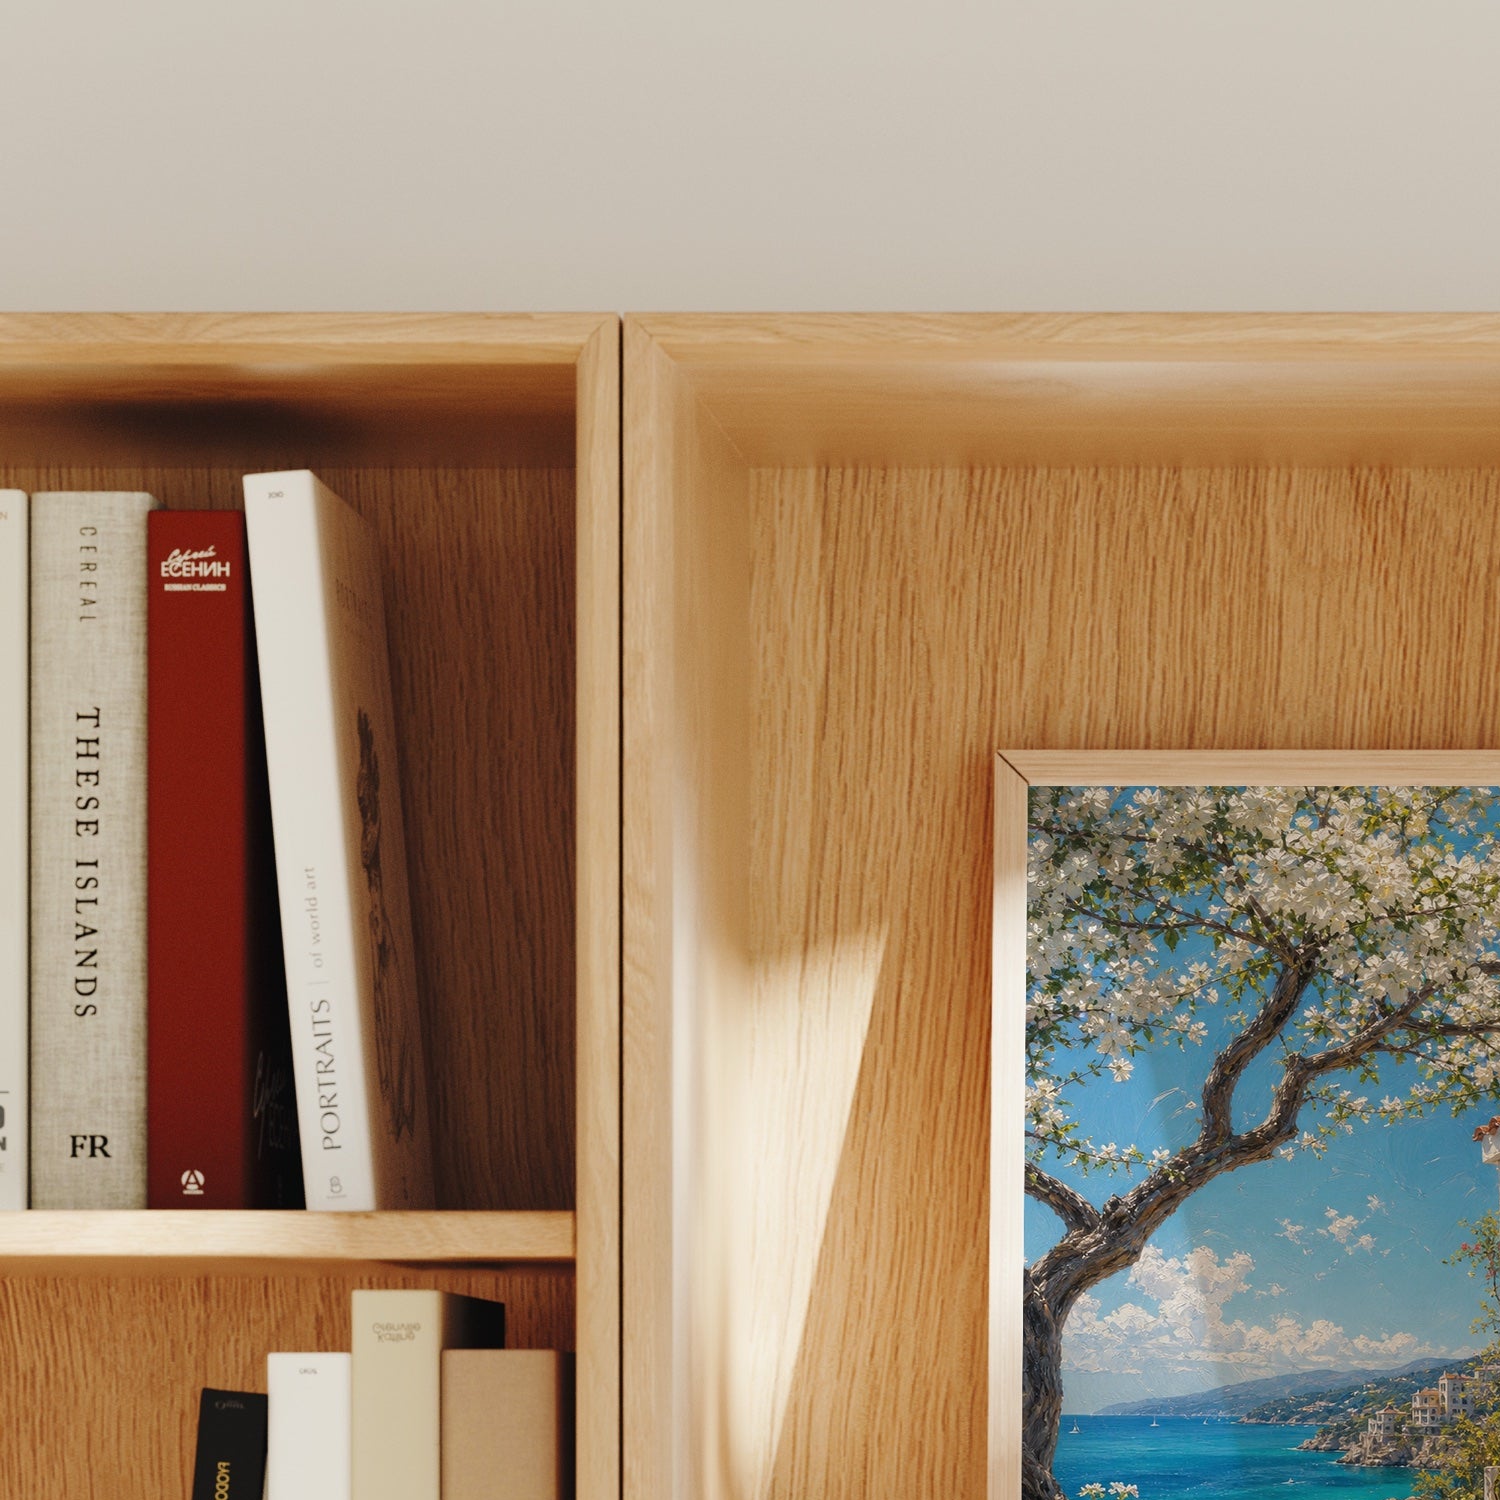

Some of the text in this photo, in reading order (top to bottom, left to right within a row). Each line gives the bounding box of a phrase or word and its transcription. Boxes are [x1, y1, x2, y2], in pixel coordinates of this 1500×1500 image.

[79, 526, 98, 622] CEREAL
[160, 561, 231, 577] ЕСЕНИН
[74, 706, 101, 1018] THESE ISLANDS
[303, 866, 342, 1151] PORTRAITS of world art
[69, 1134, 112, 1158] FR
